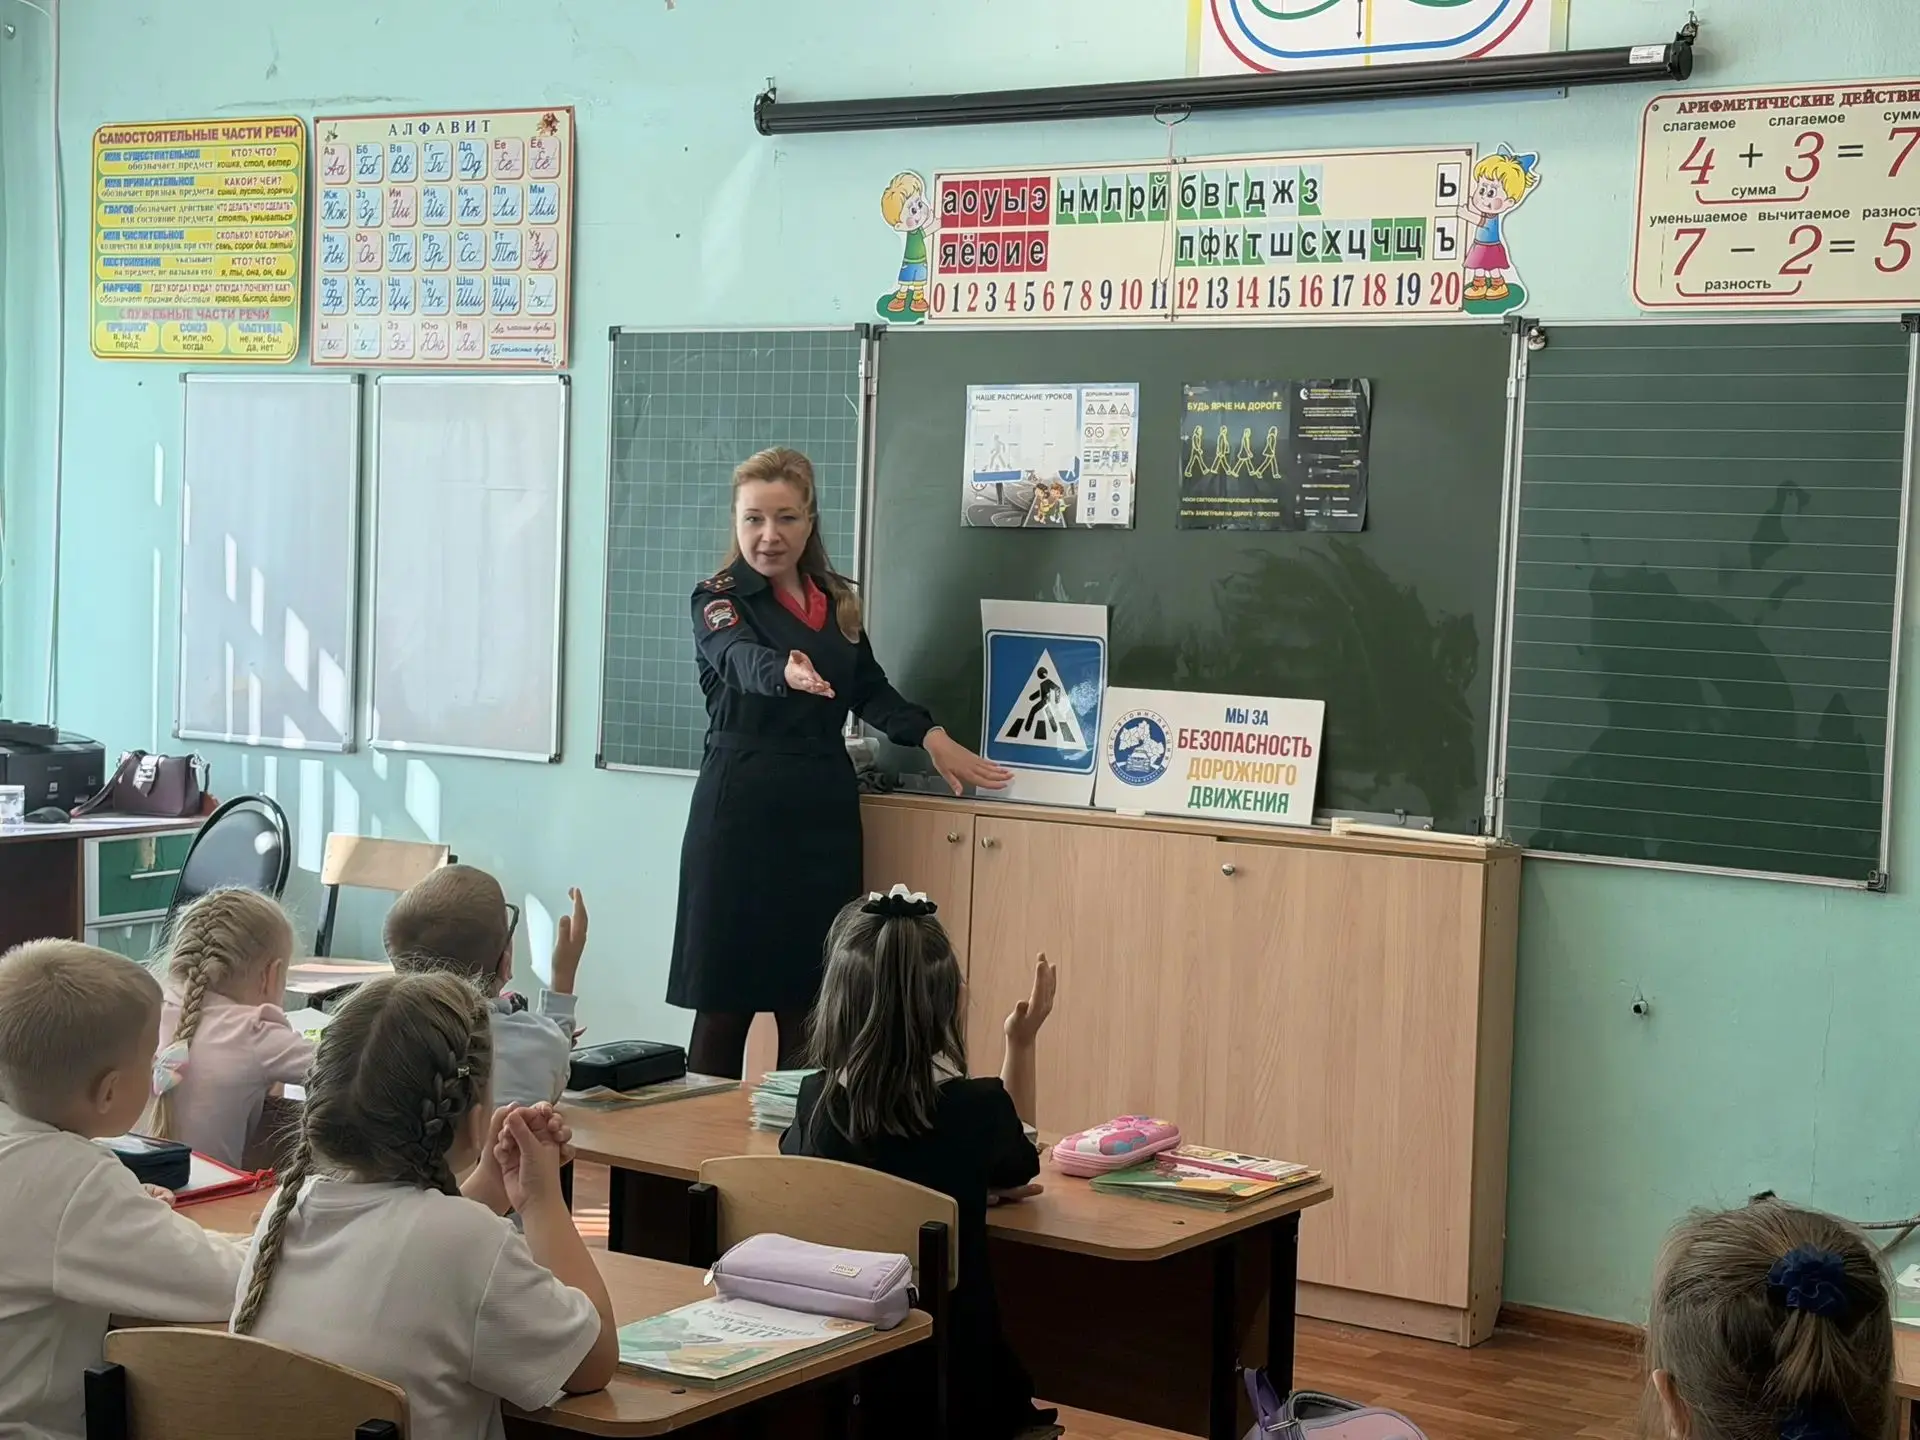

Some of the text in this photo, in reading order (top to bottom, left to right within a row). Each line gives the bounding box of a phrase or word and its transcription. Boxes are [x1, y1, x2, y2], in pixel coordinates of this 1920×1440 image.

[1677, 94, 1834, 114] АРИФМЕТИЧЕСКИЕ
[388, 119, 491, 136] АЛФАВИТ
[1663, 111, 1920, 132] слагаемое слагаемое сумм
[99, 126, 298, 145] САМОСТОЯТЕЛЬНЫЕ ЧАСТИ РЕЧИ
[231, 147, 276, 157] КТО? ЧТО?
[1679, 136, 1715, 184] 4
[1785, 131, 1824, 182] 3
[1888, 127, 1920, 177] 7
[1731, 185, 1777, 197] сумма
[1650, 212, 1748, 226] уменьшаемое
[1758, 208, 1850, 222] вычитаемое
[1674, 228, 1707, 276] 7
[1779, 225, 1822, 275] 2
[1875, 222, 1917, 273] 5
[231, 256, 276, 266] КТО? ЧТО?
[934, 271, 1460, 312] 0 1 2 3 4 5 6 7 8 9 10 11 12 13 14 15 16 17 18 19 20
[1705, 279, 1771, 292] разность
[1187, 402, 1282, 411] БУДЬ ЯРЧЕ НА ДОРОГЕ
[1225, 707, 1268, 726] МЫ ЗА
[1178, 728, 1312, 758] БЕЗОПАСНОСТЬ
[1187, 757, 1297, 786] ДОРОЖНОГО
[1188, 785, 1289, 814] ДВИЖЕНИЯ
